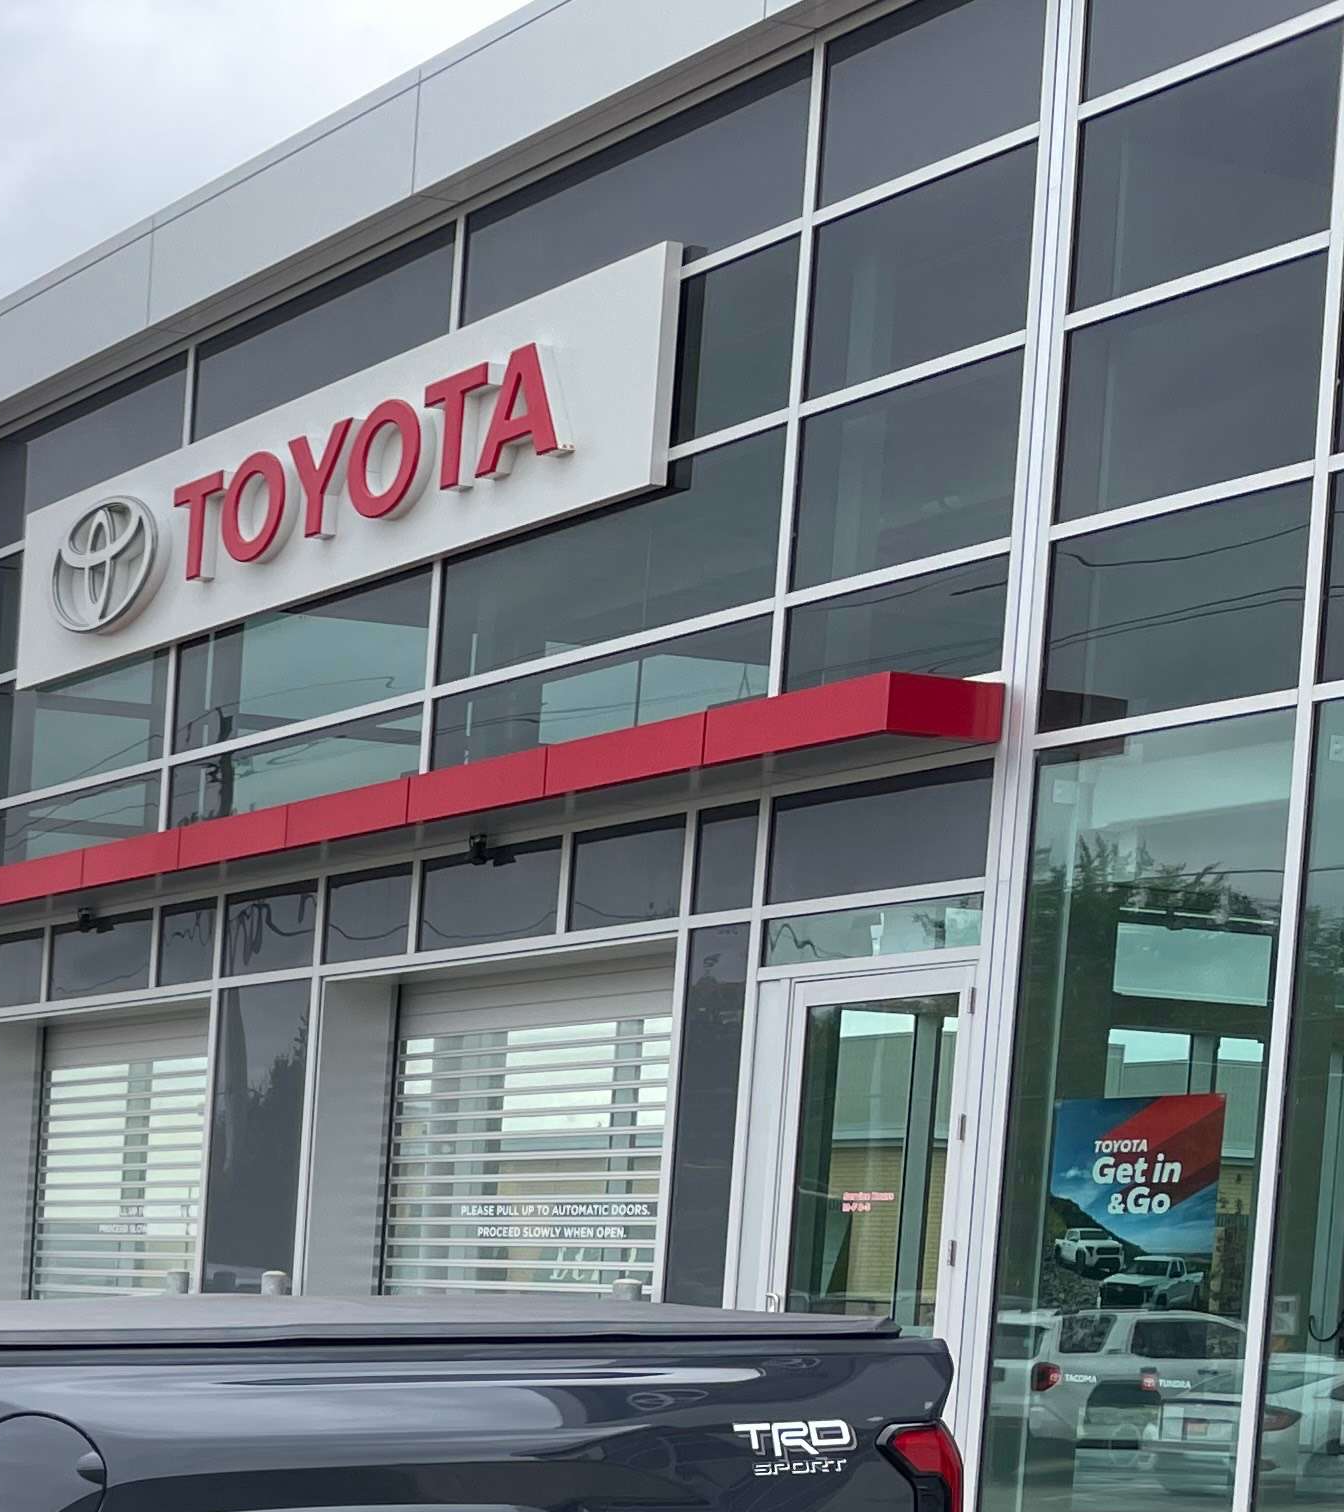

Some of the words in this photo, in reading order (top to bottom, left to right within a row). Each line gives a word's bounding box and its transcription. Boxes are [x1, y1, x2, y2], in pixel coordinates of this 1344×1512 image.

[173, 342, 567, 581] TOYOTA
[1094, 1139, 1148, 1153] TOYOTA
[1092, 1156, 1148, 1184] Get
[1152, 1153, 1182, 1184] in
[461, 1205, 494, 1216] PLEASE
[496, 1205, 520, 1216] PULL
[522, 1205, 534, 1216] UP
[537, 1205, 550, 1216] TO
[552, 1205, 608, 1216] AUTOMATIC
[611, 1204, 650, 1216] DOORS.
[478, 1226, 521, 1238] PROCEED
[523, 1226, 561, 1238] SLOWLY
[563, 1226, 594, 1238] WHEN
[596, 1226, 626, 1238] OPEN.
[1064, 1373, 1097, 1383] TACOMA
[1159, 1379, 1192, 1389] TUNDRA
[733, 1420, 852, 1457] TRD
[753, 1458, 847, 1476] SPORT
